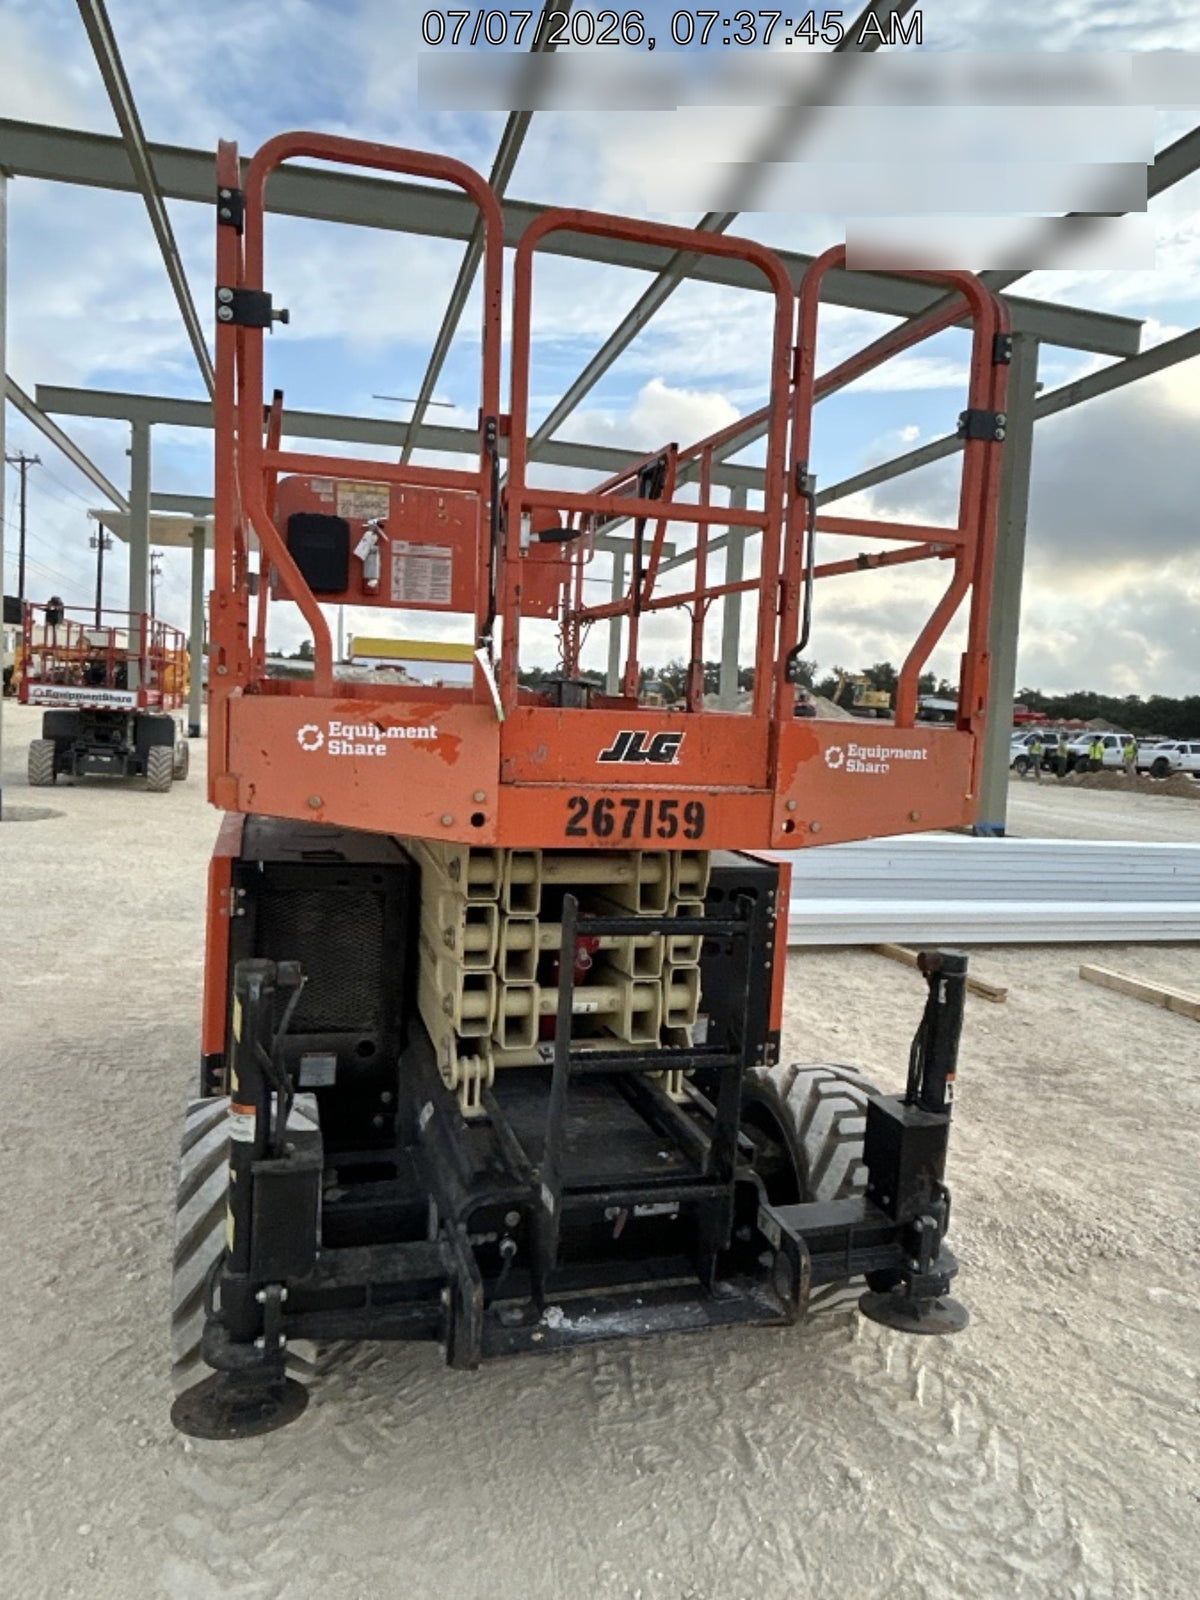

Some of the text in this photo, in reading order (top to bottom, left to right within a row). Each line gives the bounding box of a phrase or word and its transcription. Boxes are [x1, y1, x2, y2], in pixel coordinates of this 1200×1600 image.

[328, 739, 387, 756] Share
[596, 730, 686, 765] JLG
[848, 743, 928, 761] Equipment
[846, 759, 890, 774] Share
[565, 796, 705, 839] 267159
